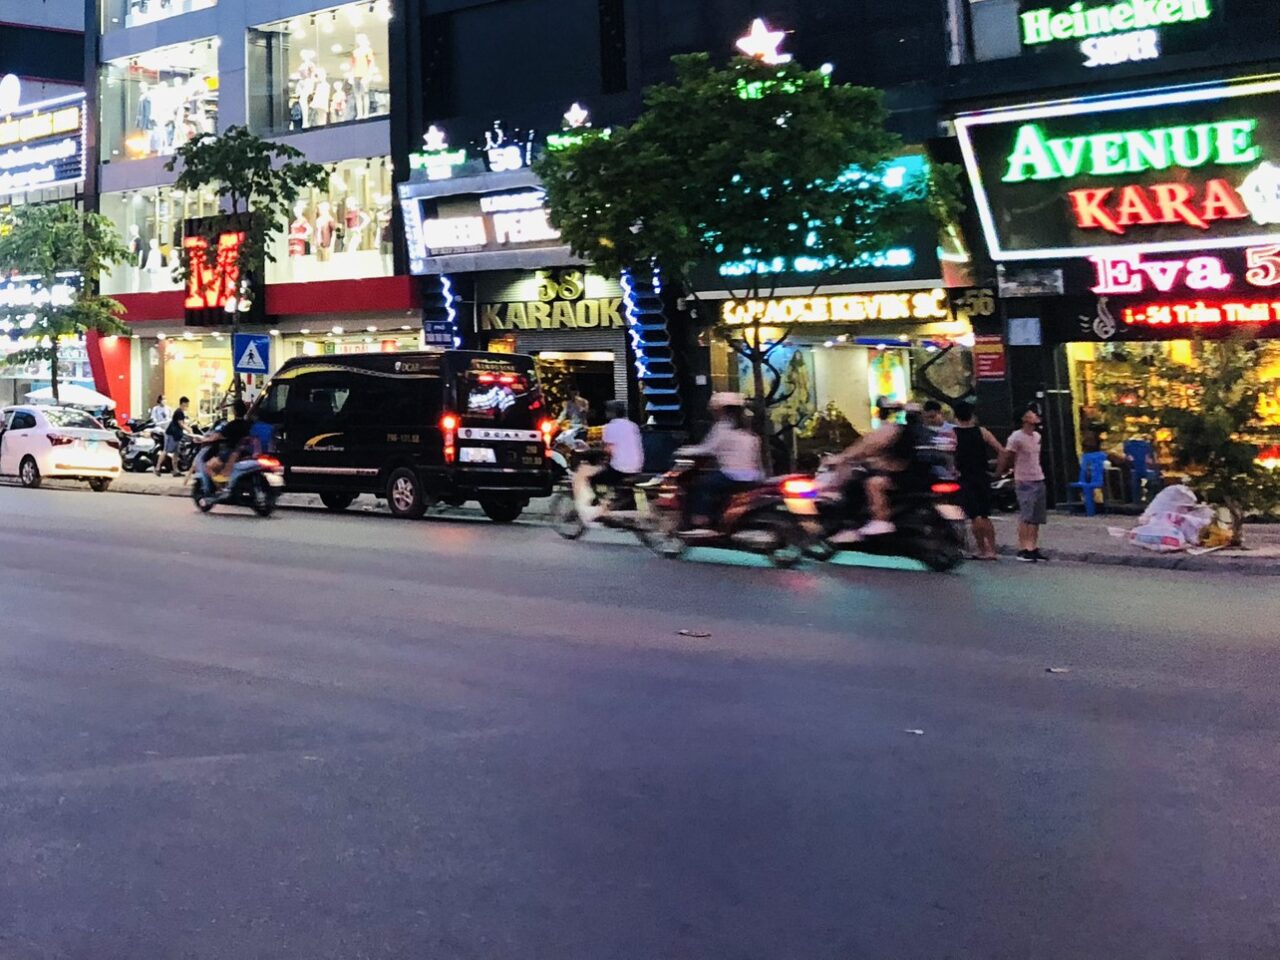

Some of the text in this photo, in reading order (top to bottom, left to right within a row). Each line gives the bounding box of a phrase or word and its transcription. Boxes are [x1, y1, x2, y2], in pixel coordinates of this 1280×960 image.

[1001, 119, 1262, 182] AVENUE
[535, 269, 585, 303] 58
[1089, 251, 1233, 294] Eva
[481, 297, 626, 330] KARAOK
